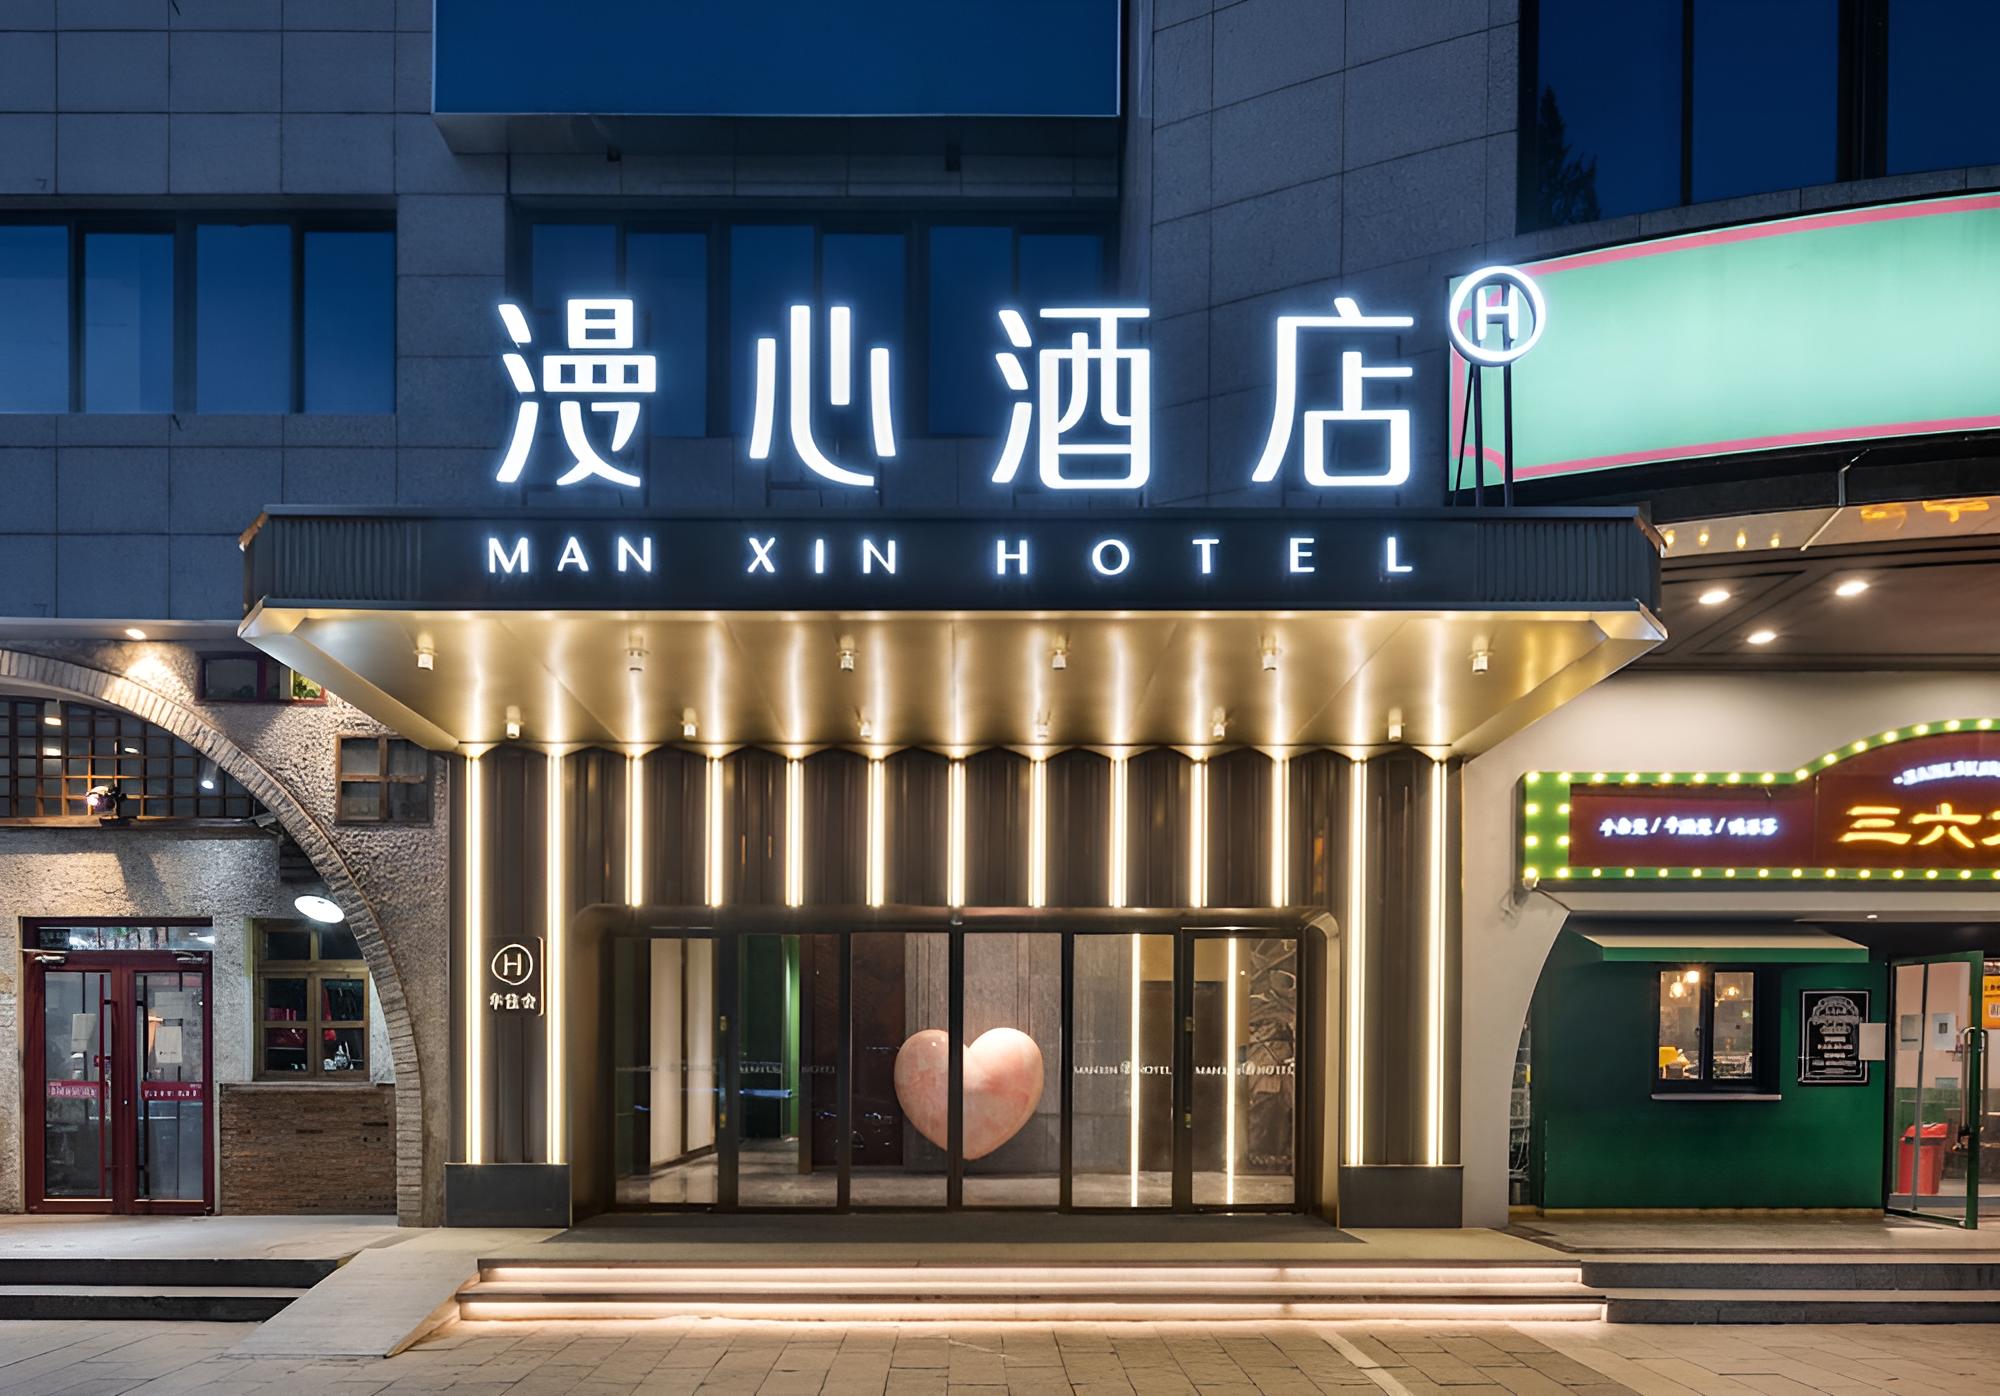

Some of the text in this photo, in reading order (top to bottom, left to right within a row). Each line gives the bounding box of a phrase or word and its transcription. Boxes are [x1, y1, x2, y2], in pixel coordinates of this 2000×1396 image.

[495, 297, 1415, 489] 漫心酒店
[488, 536, 1413, 576] MAN XIN HOTEL
